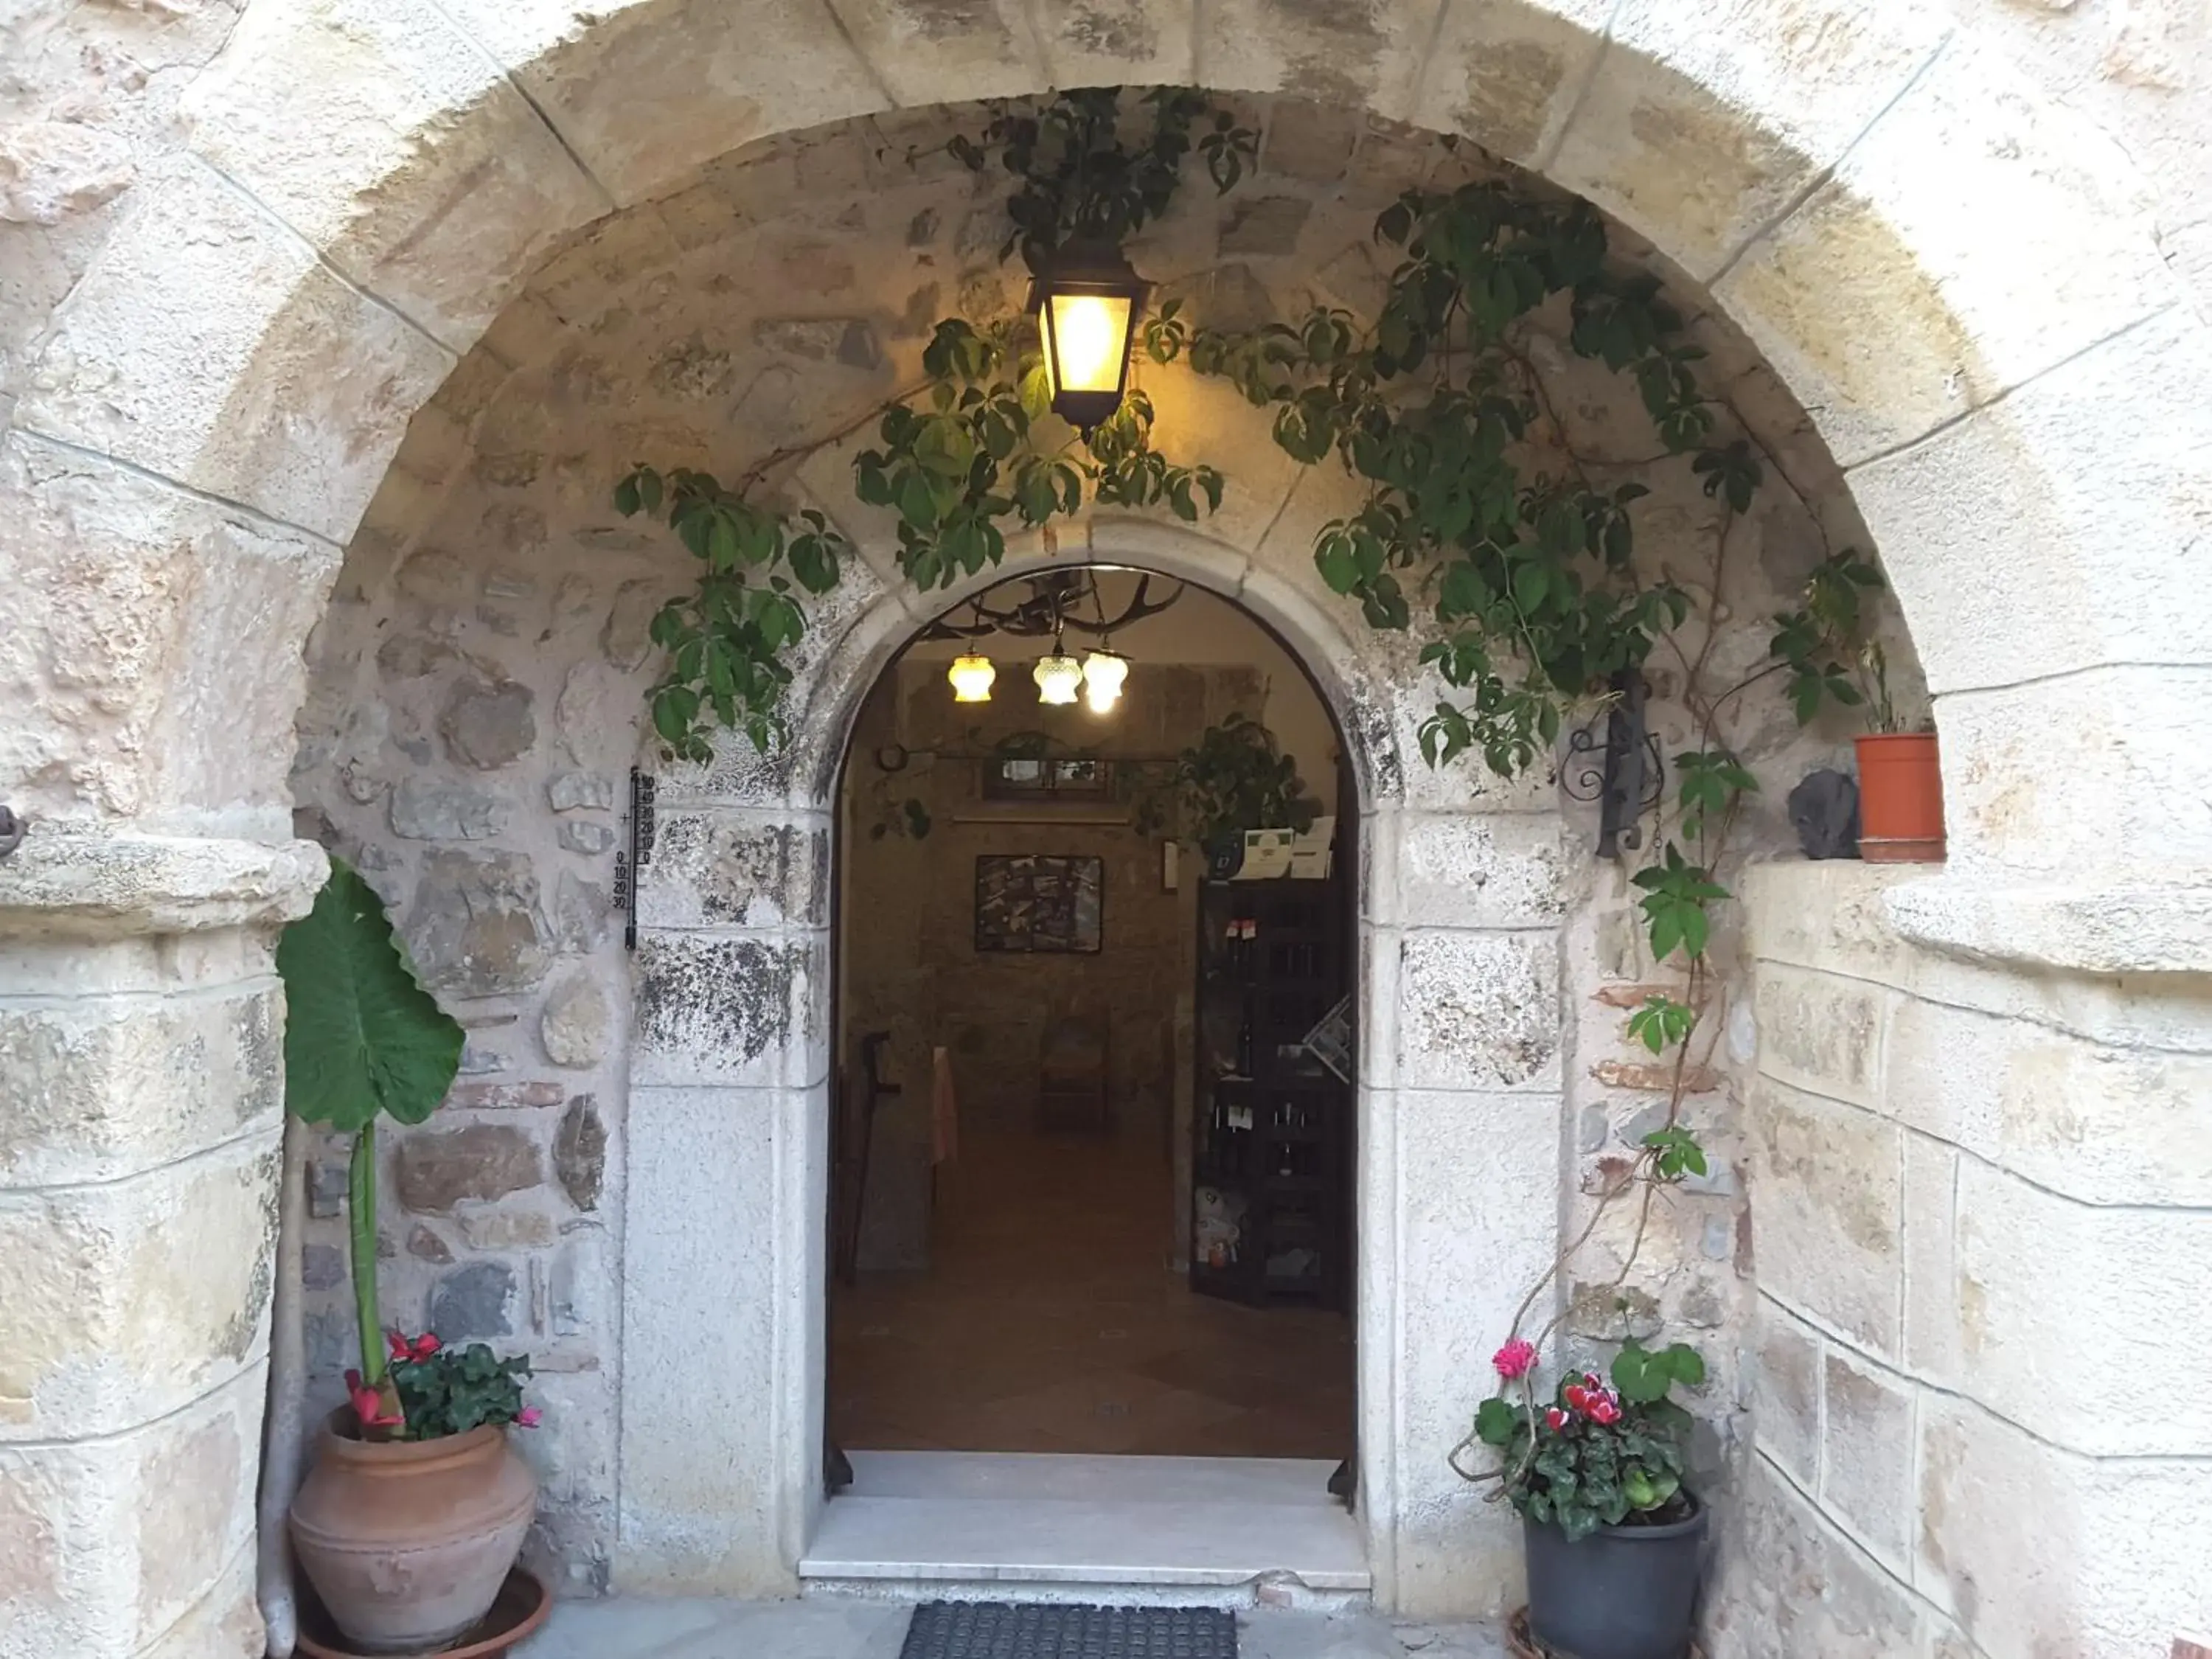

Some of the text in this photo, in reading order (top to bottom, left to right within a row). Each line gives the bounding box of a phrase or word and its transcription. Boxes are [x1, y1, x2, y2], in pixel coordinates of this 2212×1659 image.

[641, 821, 654, 833] 20
[641, 836, 654, 848] 10
[616, 851, 624, 863] 0
[644, 851, 650, 863] 0
[613, 866, 626, 878] 10
[613, 881, 626, 894] 20
[613, 896, 626, 908] 30
